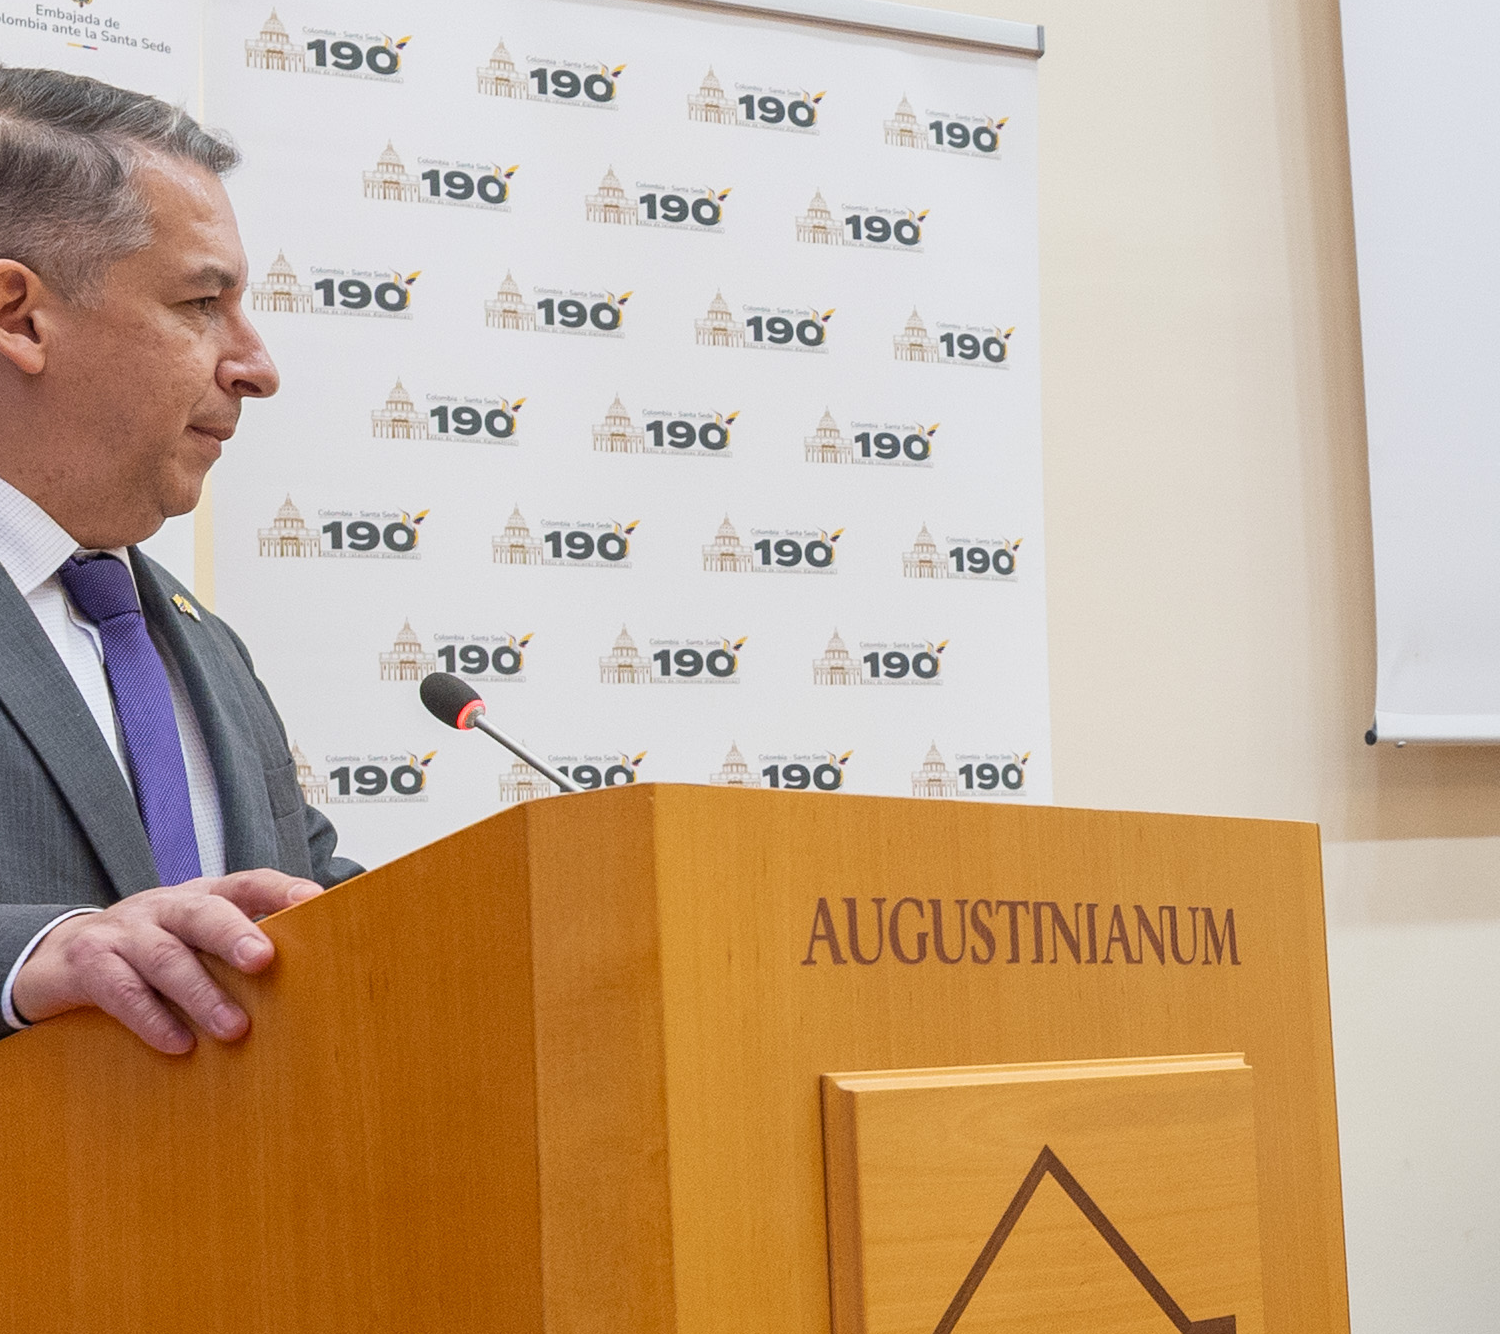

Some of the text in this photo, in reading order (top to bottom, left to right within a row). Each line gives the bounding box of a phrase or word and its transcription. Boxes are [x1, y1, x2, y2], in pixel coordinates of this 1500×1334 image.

[36, 4, 120, 29] Embajada de
[52, 25, 81, 37] ante
[85, 27, 97, 39] la
[101, 30, 137, 47] Santa
[141, 38, 171, 54] Sede
[307, 40, 398, 74] 190
[739, 95, 814, 127] 190
[930, 121, 997, 152] 190
[422, 170, 506, 204] 190
[538, 299, 619, 330] 190
[431, 406, 513, 438] 190
[755, 539, 832, 567] 190
[654, 649, 735, 677] 190
[330, 765, 422, 795] 190
[801, 896, 1241, 966] AUGUSTINIANUM
